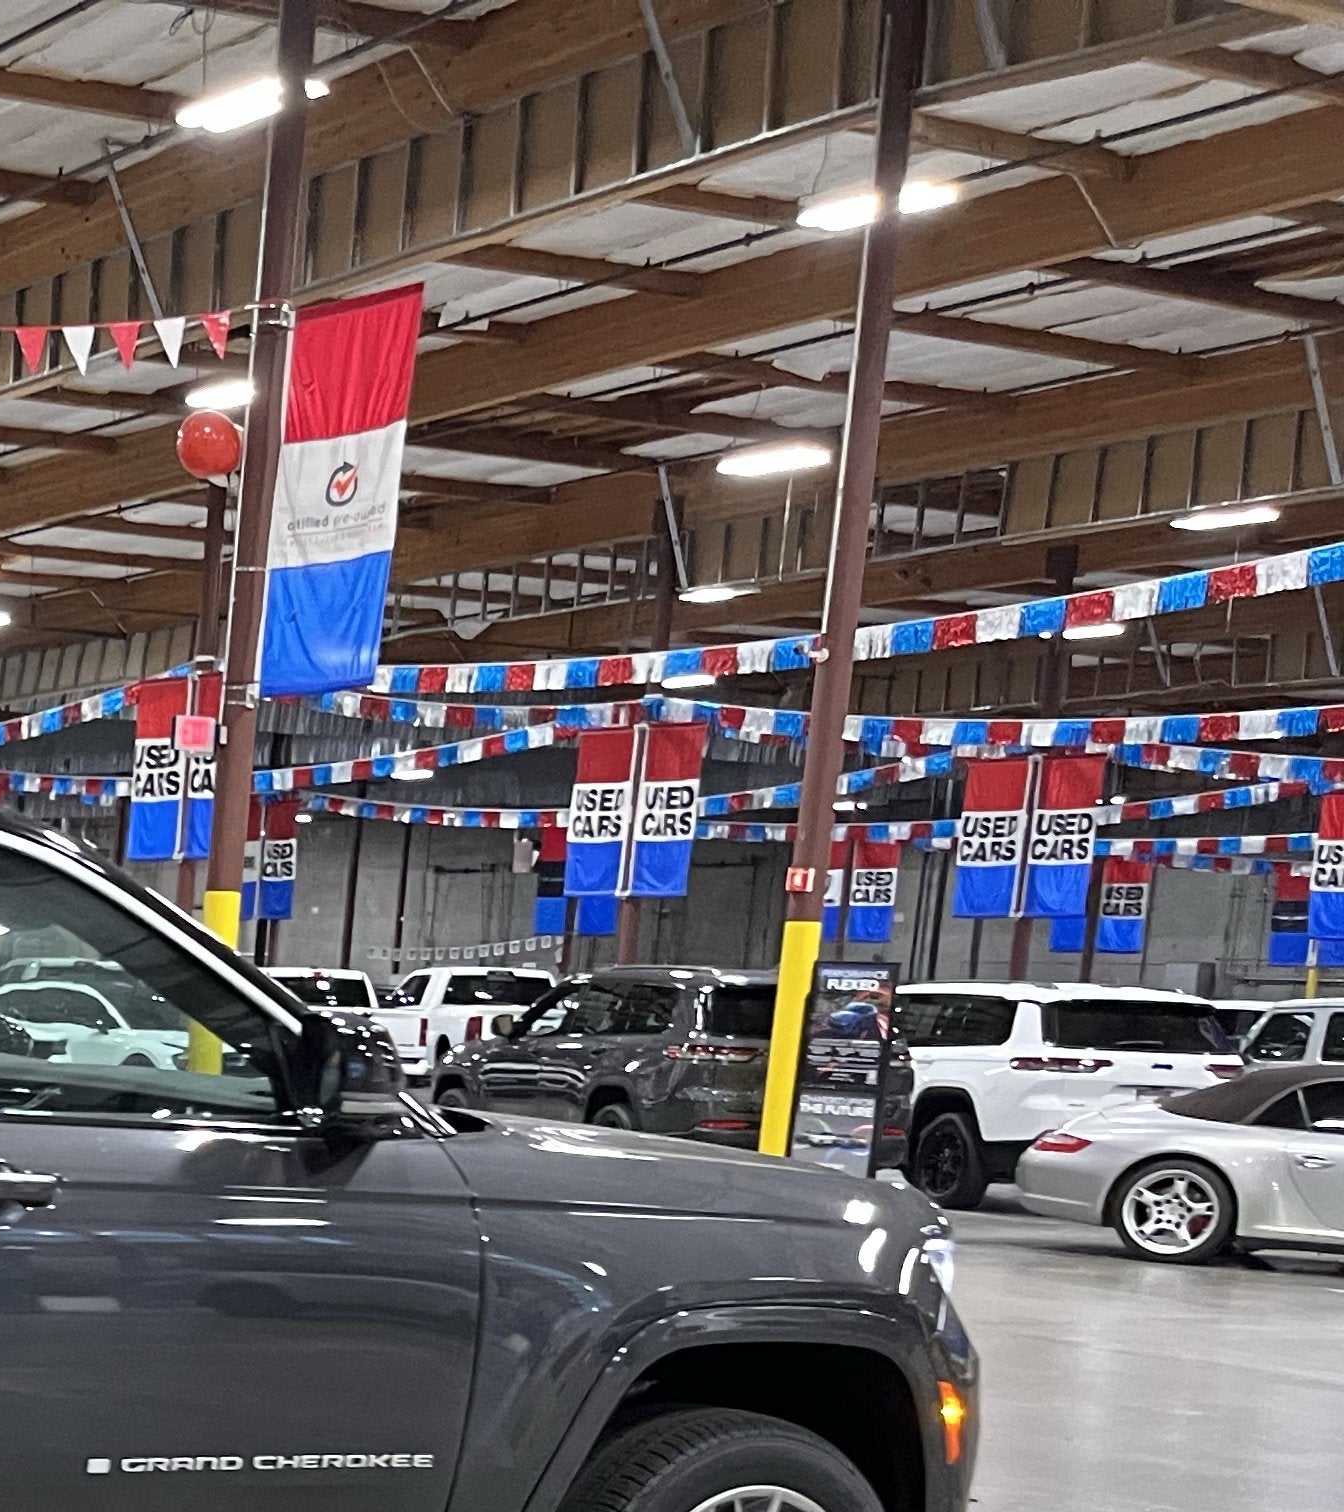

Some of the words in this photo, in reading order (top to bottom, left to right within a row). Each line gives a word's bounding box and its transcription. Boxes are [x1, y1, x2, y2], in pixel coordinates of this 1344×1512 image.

[191, 768, 214, 793] CA
[964, 815, 1018, 839] USED
[1035, 813, 1093, 837] USED
[266, 843, 294, 860] SED
[960, 839, 1016, 862] CARS
[1031, 837, 1090, 861] CARS
[1317, 844, 1344, 866] US
[121, 1456, 243, 1472] GRAND
[252, 1454, 434, 1470] CHEROKEE
